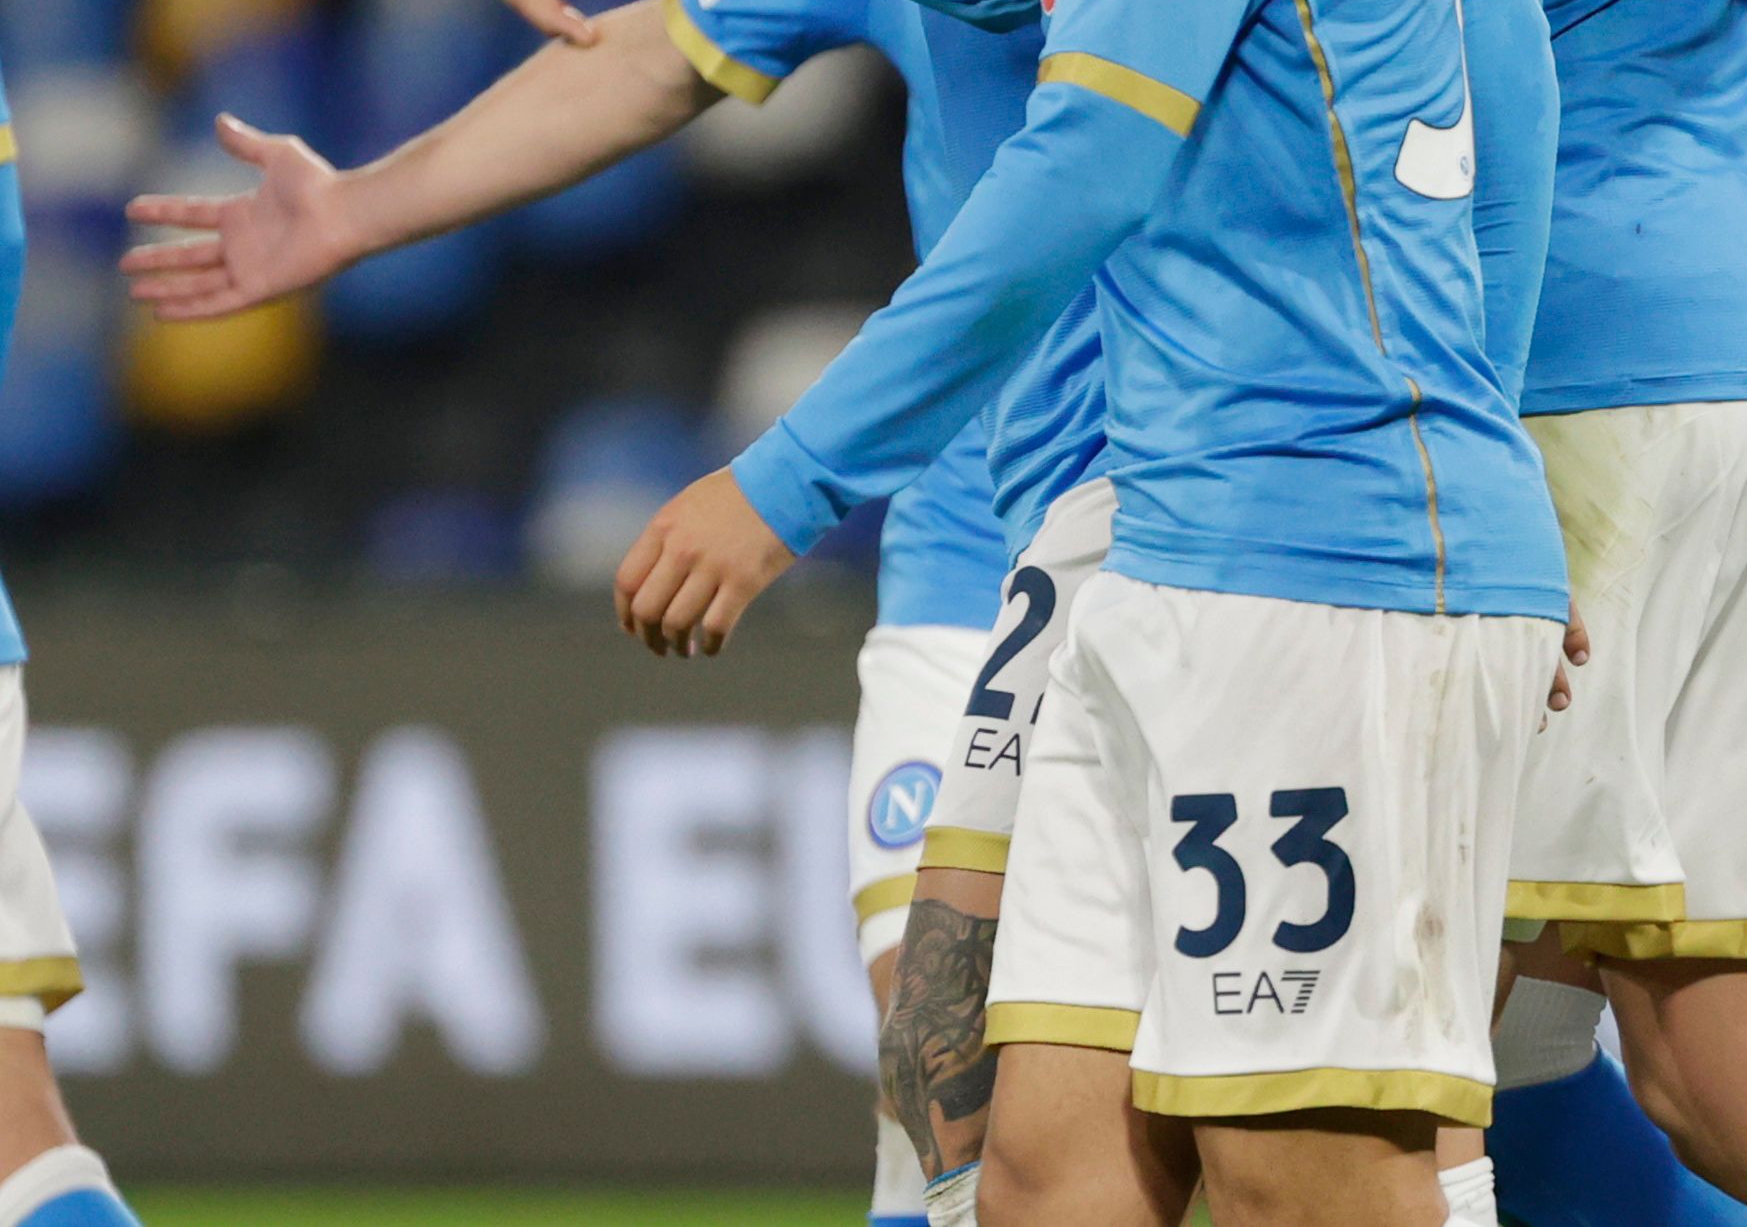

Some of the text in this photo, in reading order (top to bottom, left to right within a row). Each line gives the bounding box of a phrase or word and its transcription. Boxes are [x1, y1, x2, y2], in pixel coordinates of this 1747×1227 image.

[963, 729, 1022, 777] EA
[1170, 786, 1357, 959] 33
[1212, 970, 1321, 1016] EA7
